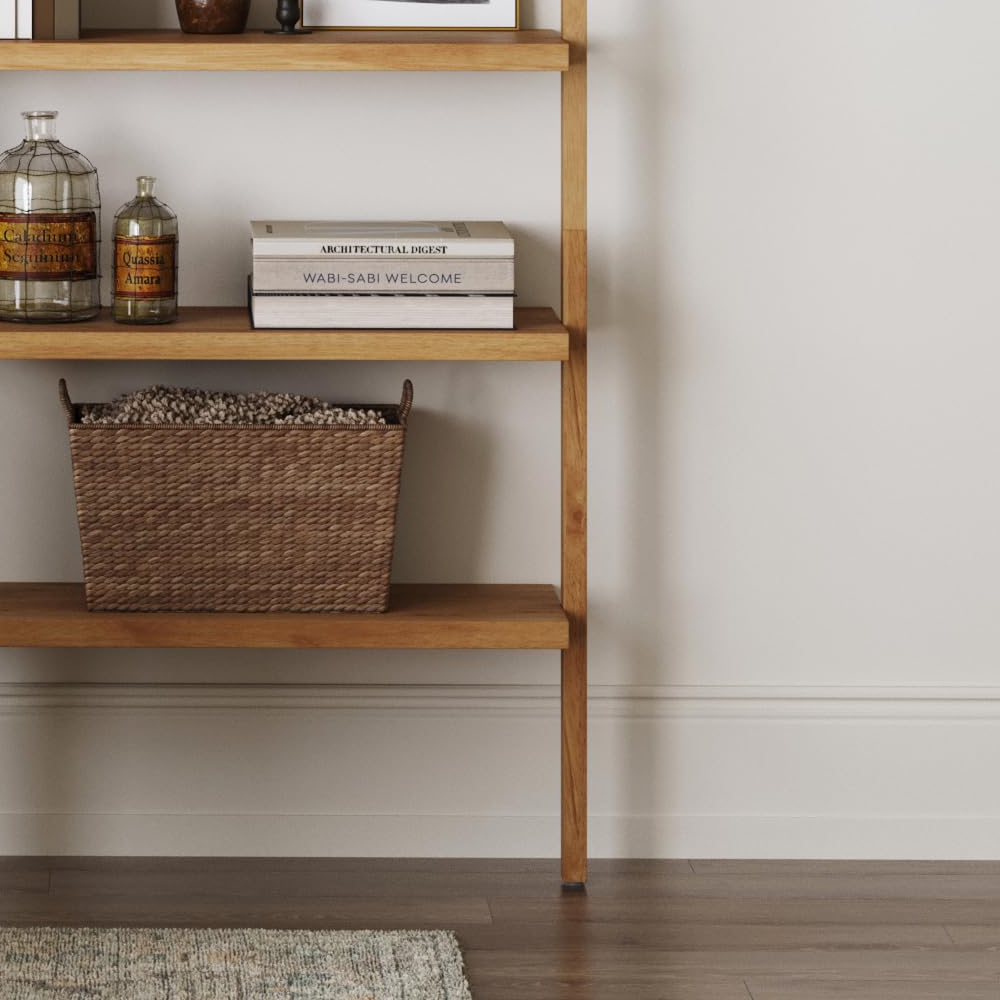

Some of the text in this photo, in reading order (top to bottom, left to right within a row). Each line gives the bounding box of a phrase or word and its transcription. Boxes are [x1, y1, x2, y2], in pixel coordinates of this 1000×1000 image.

[320, 245, 448, 255] ARCHITECTURAL DIGEST
[122, 251, 165, 267] Quassia
[125, 272, 161, 285] Amara
[303, 273, 463, 284] WABI-SABI WELCOME
